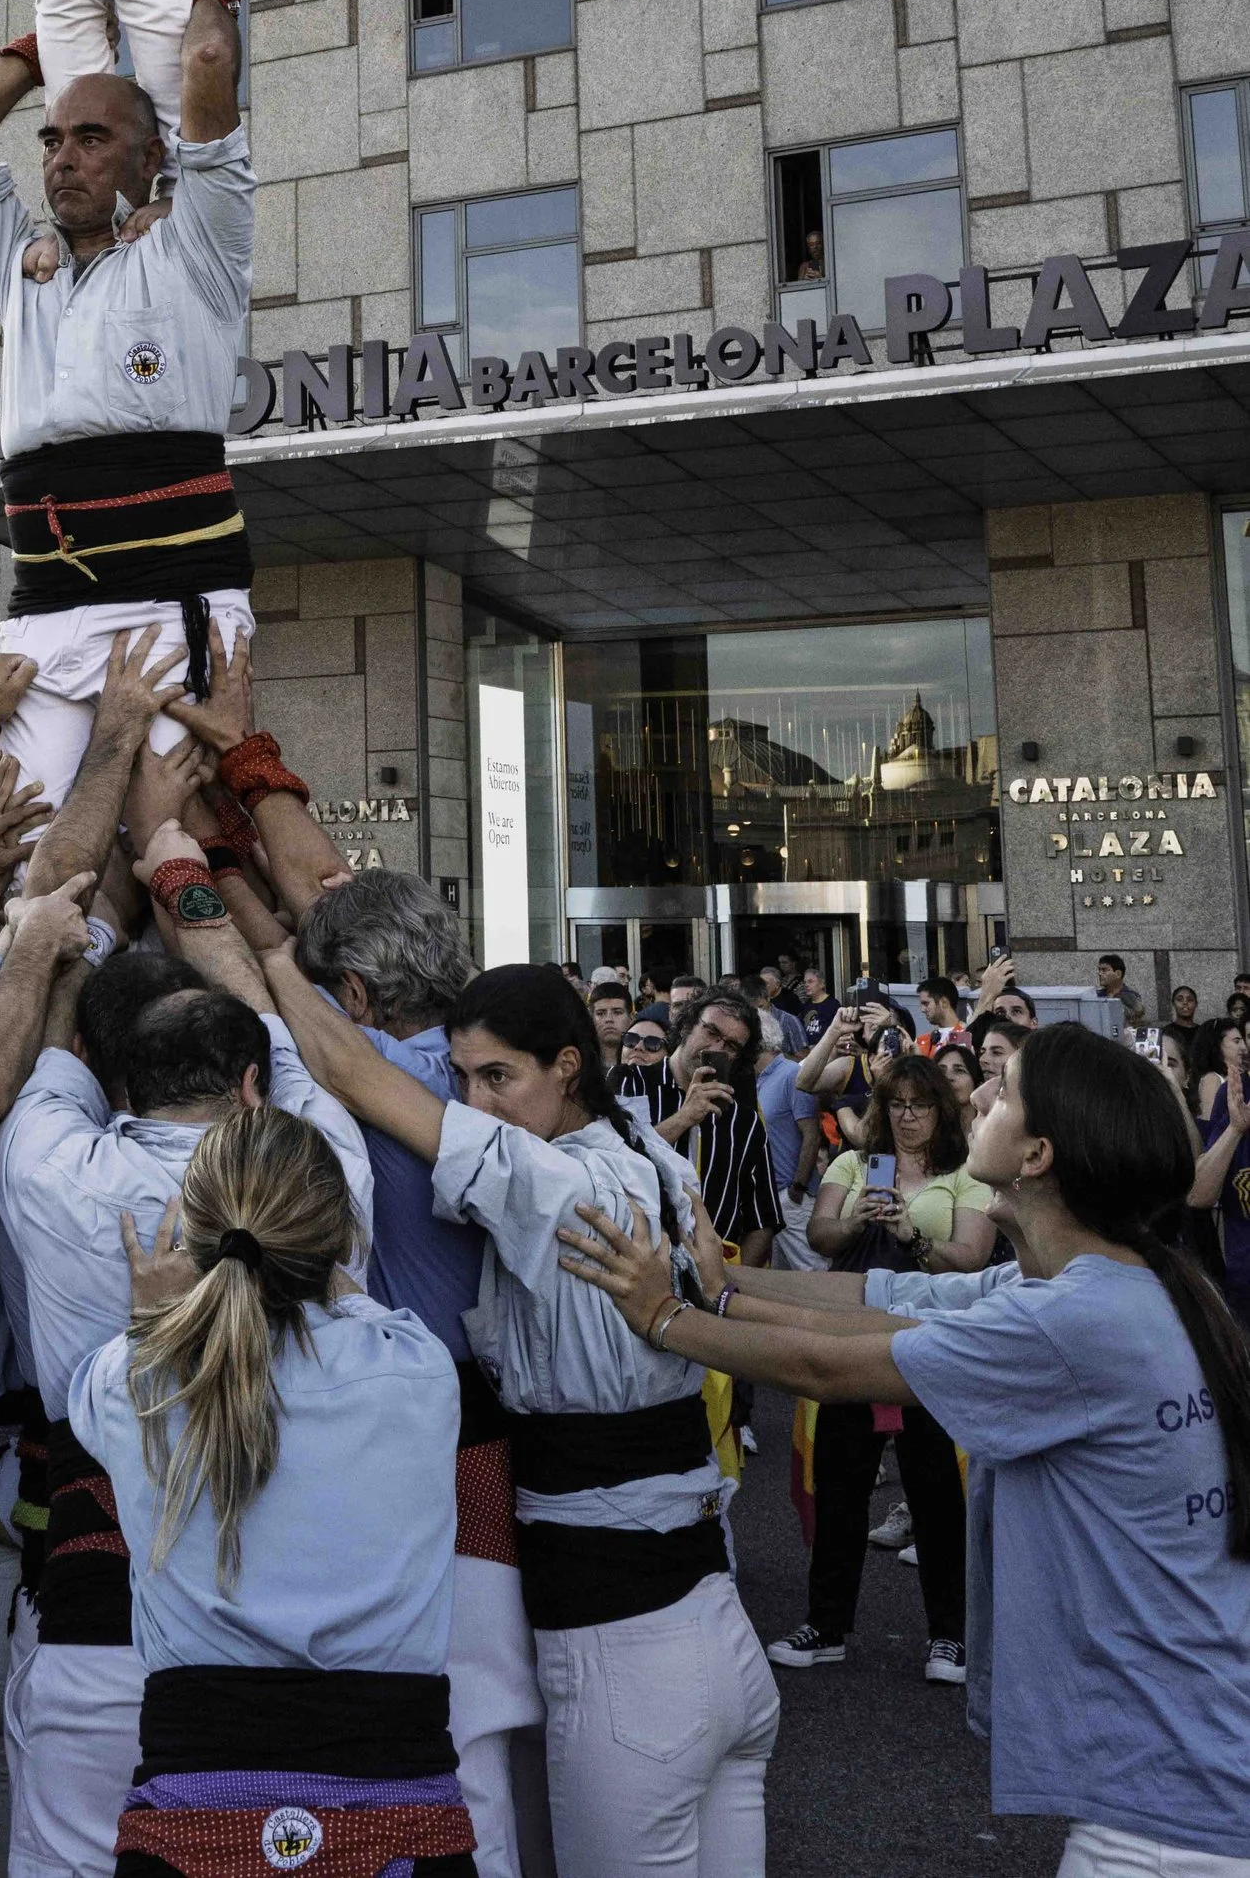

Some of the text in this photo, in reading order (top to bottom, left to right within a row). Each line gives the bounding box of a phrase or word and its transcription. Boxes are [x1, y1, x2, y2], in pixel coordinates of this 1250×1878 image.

[127, 342, 162, 358] Castellers
[471, 312, 872, 407] BARCELONA
[135, 374, 156, 383] Poble
[487, 757, 519, 775] Estamos
[488, 775, 520, 792] Abiertos
[1008, 772, 1217, 804] CATALONIA
[488, 811, 514, 829] We are
[1059, 809, 1167, 822] BARCELONA
[488, 828, 510, 848] Open
[1046, 829, 1184, 858] PLAZA
[1070, 867, 1163, 883] HOTEL
[447, 884, 456, 902] H
[267, 1809, 317, 1831] Castellers
[264, 1839, 277, 1859] del
[276, 1854, 307, 1867] Poble
